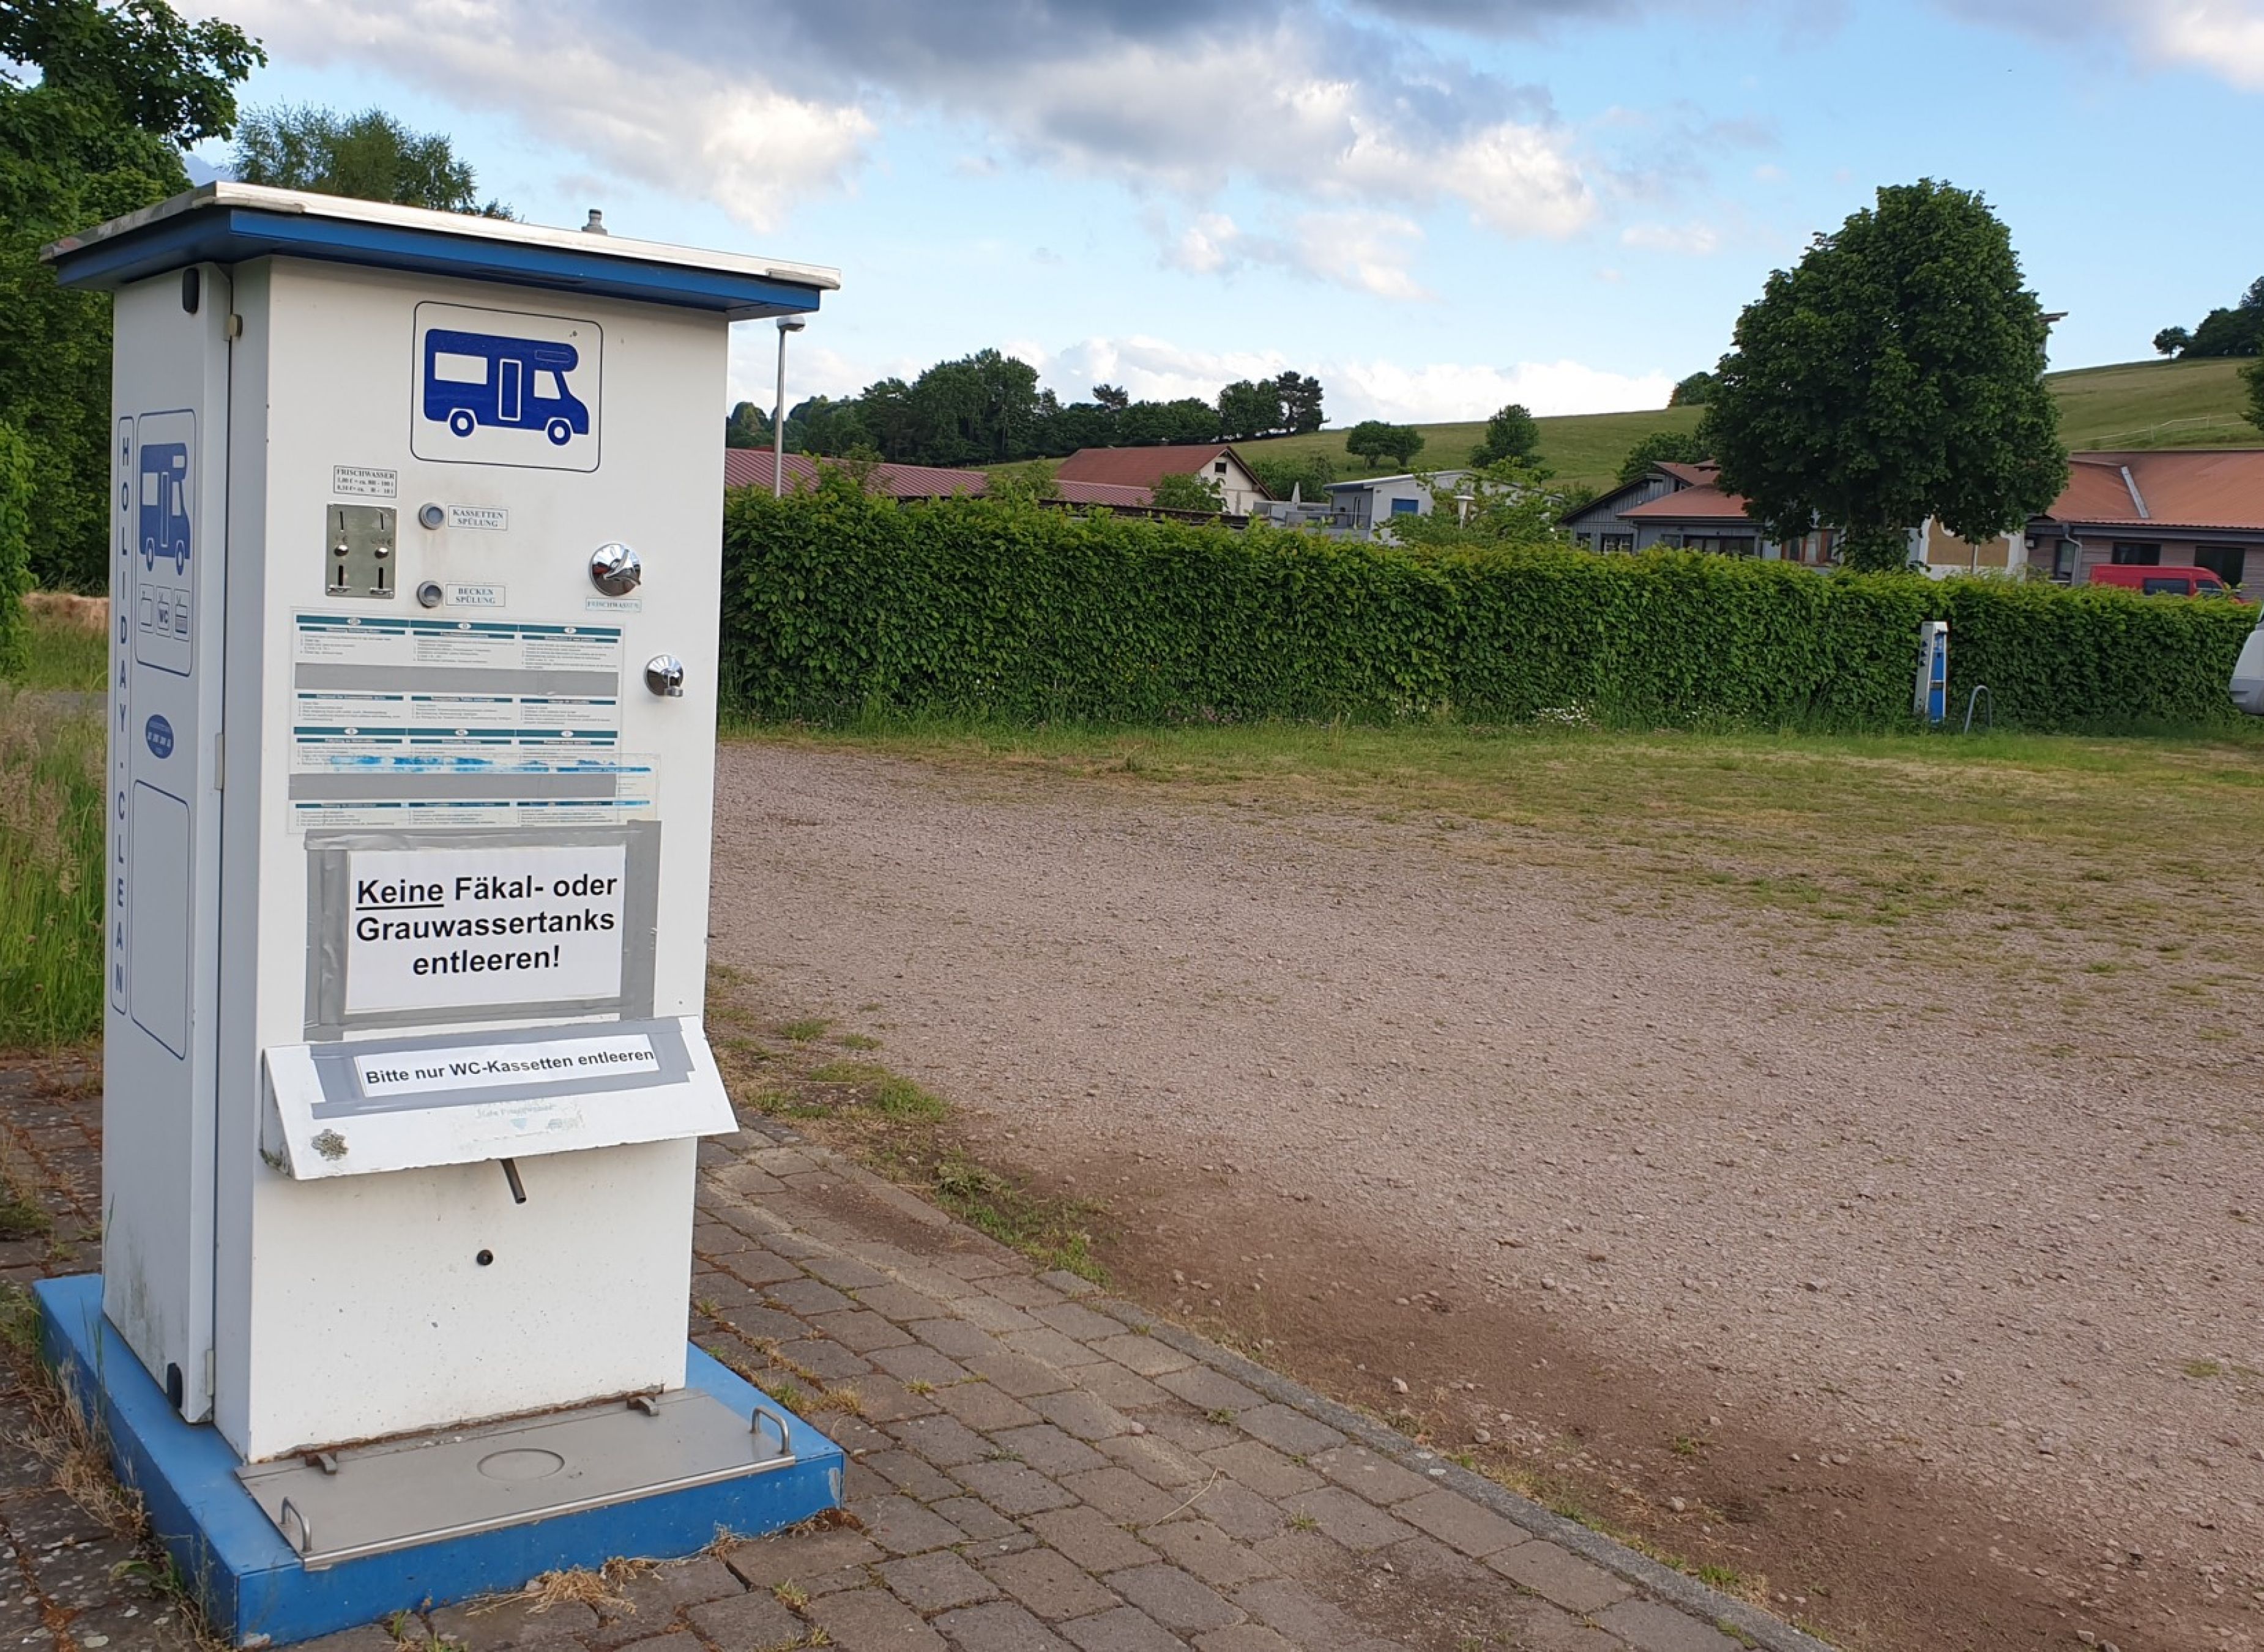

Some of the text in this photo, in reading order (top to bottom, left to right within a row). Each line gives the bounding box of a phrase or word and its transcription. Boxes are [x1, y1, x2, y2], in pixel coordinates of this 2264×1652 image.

[337, 468, 395, 480] FRISCHWASSER
[453, 509, 503, 519] KASSETTEN
[458, 517, 498, 528] SPÜLUNG
[456, 595, 495, 604] SPÜLUNG
[116, 791, 125, 994] CLEAN
[357, 873, 618, 904] Keine Fäkal- oder
[356, 909, 615, 942] Grauwassertanks
[413, 944, 560, 975] entleeren!
[367, 1049, 655, 1085] Bitte nur WC-Kassetten entleeren
